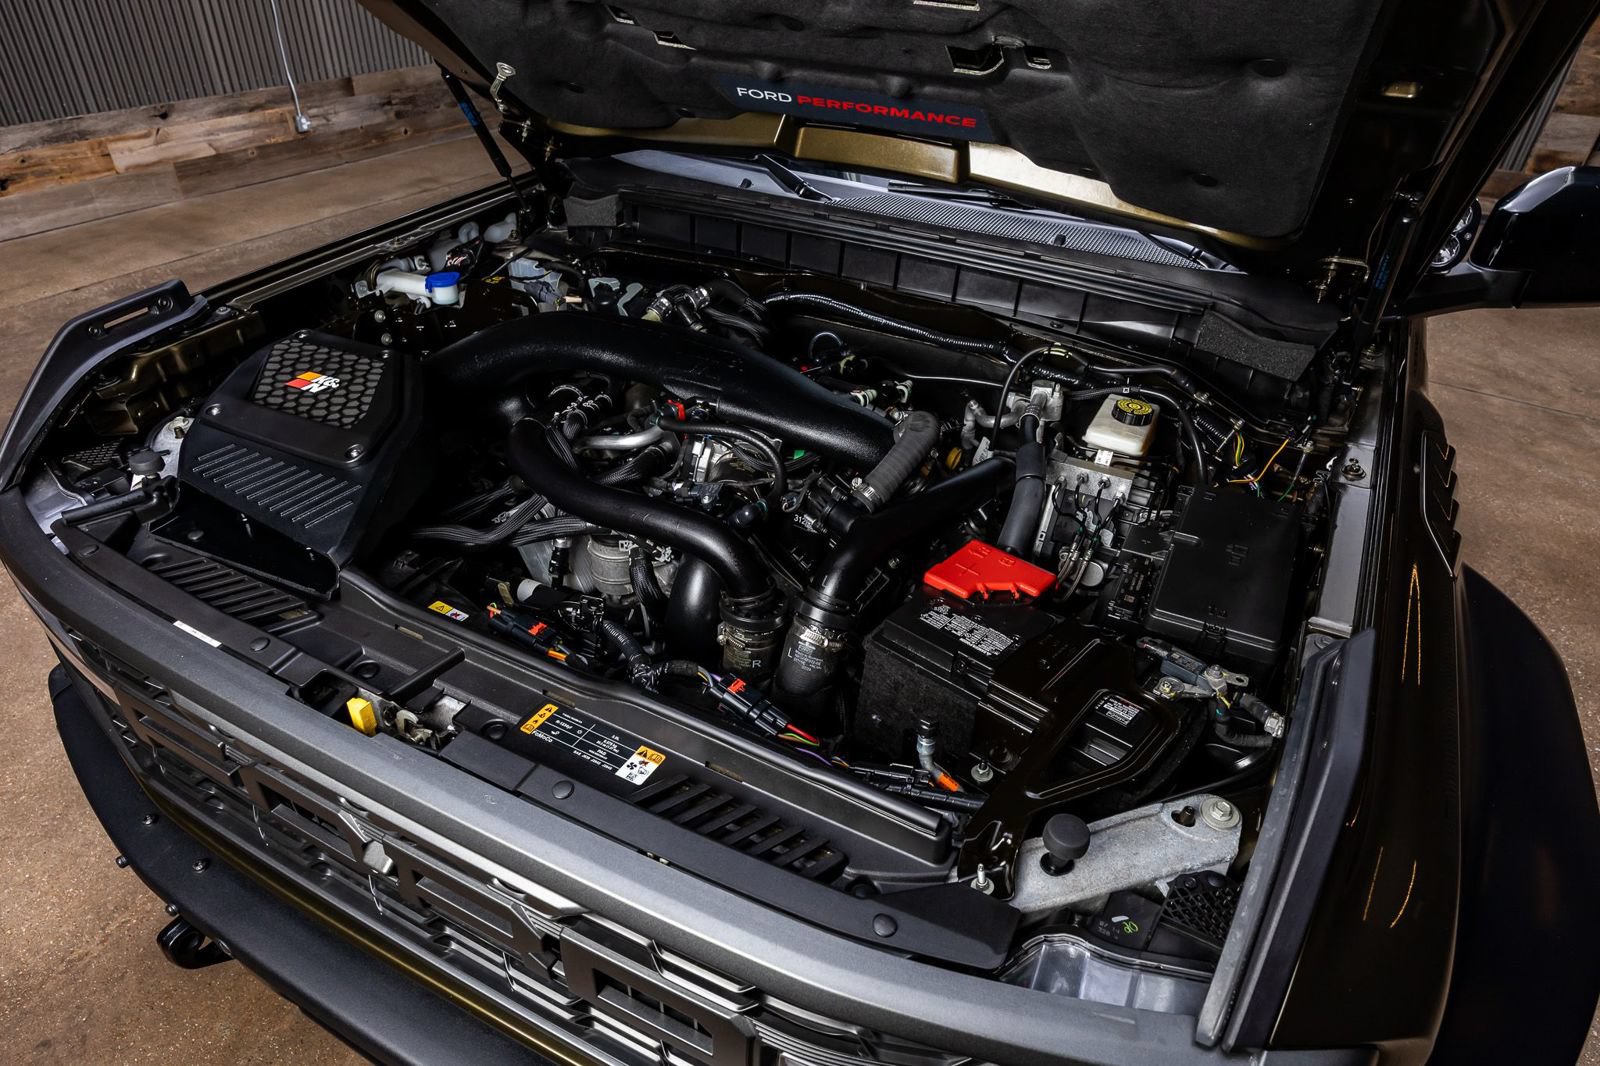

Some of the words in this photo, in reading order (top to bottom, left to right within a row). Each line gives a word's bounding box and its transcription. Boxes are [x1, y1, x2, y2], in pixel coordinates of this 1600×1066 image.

[736, 87, 792, 103] FORD
[796, 95, 977, 128] PERFORMANCE
[752, 659, 762, 669] R
[532, 730, 553, 743] FoMoCo
